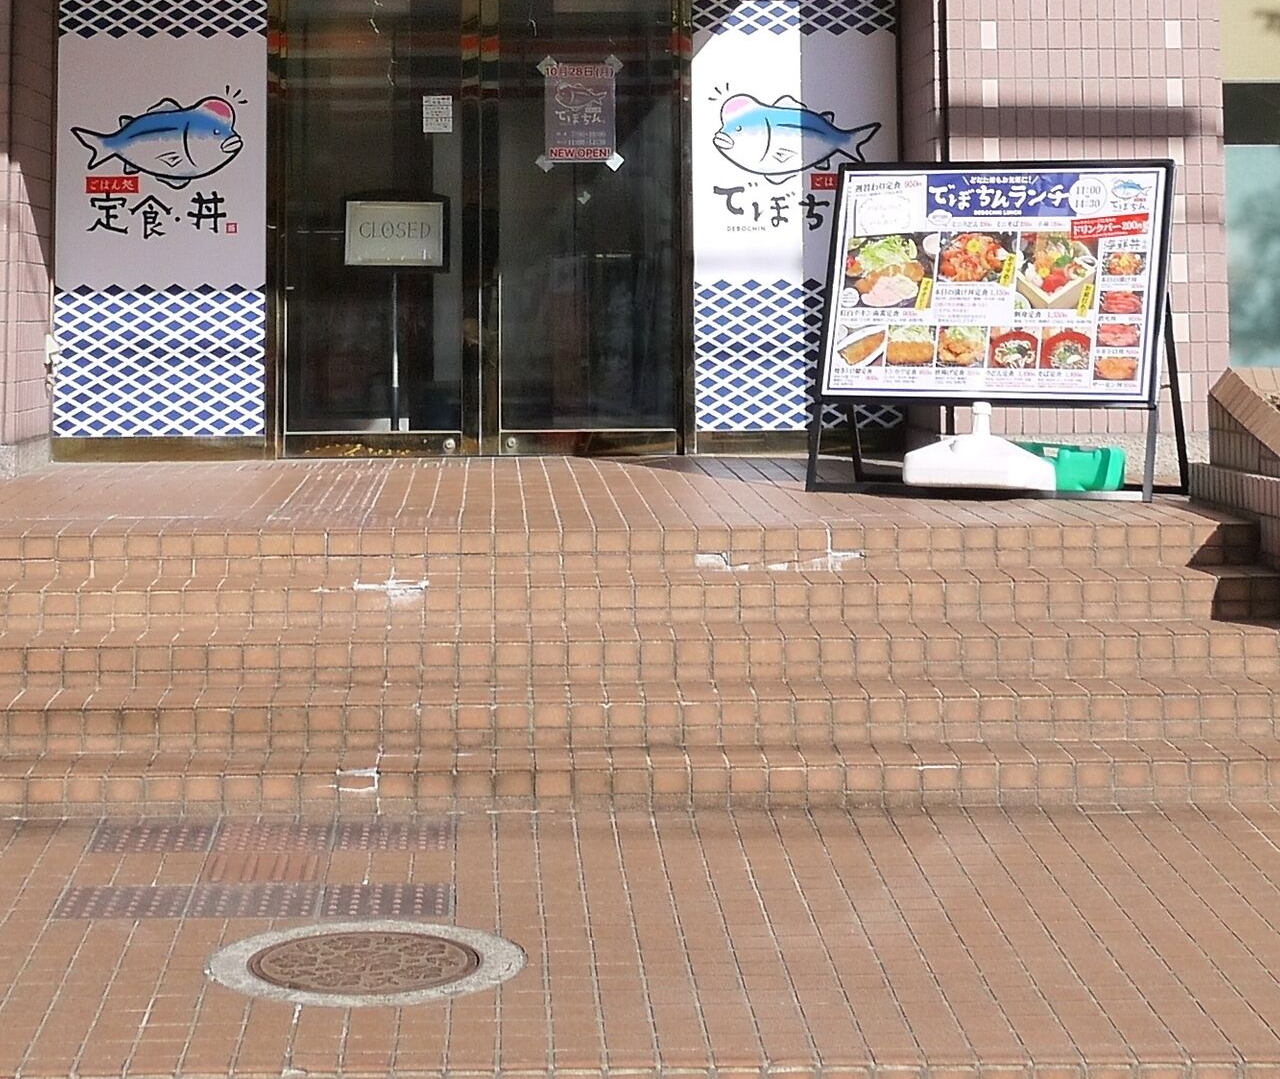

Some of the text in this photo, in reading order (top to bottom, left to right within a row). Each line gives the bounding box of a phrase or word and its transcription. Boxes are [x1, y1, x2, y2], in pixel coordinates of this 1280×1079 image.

[549, 149, 610, 158] NEW OPEN!
[89, 179, 135, 191] ごはん処
[814, 176, 835, 187] ごは
[1076, 185, 1102, 195] 11:00
[928, 184, 1071, 211] でぼちんランチ
[713, 182, 831, 232] でぼち
[359, 221, 431, 239] CLOSED
